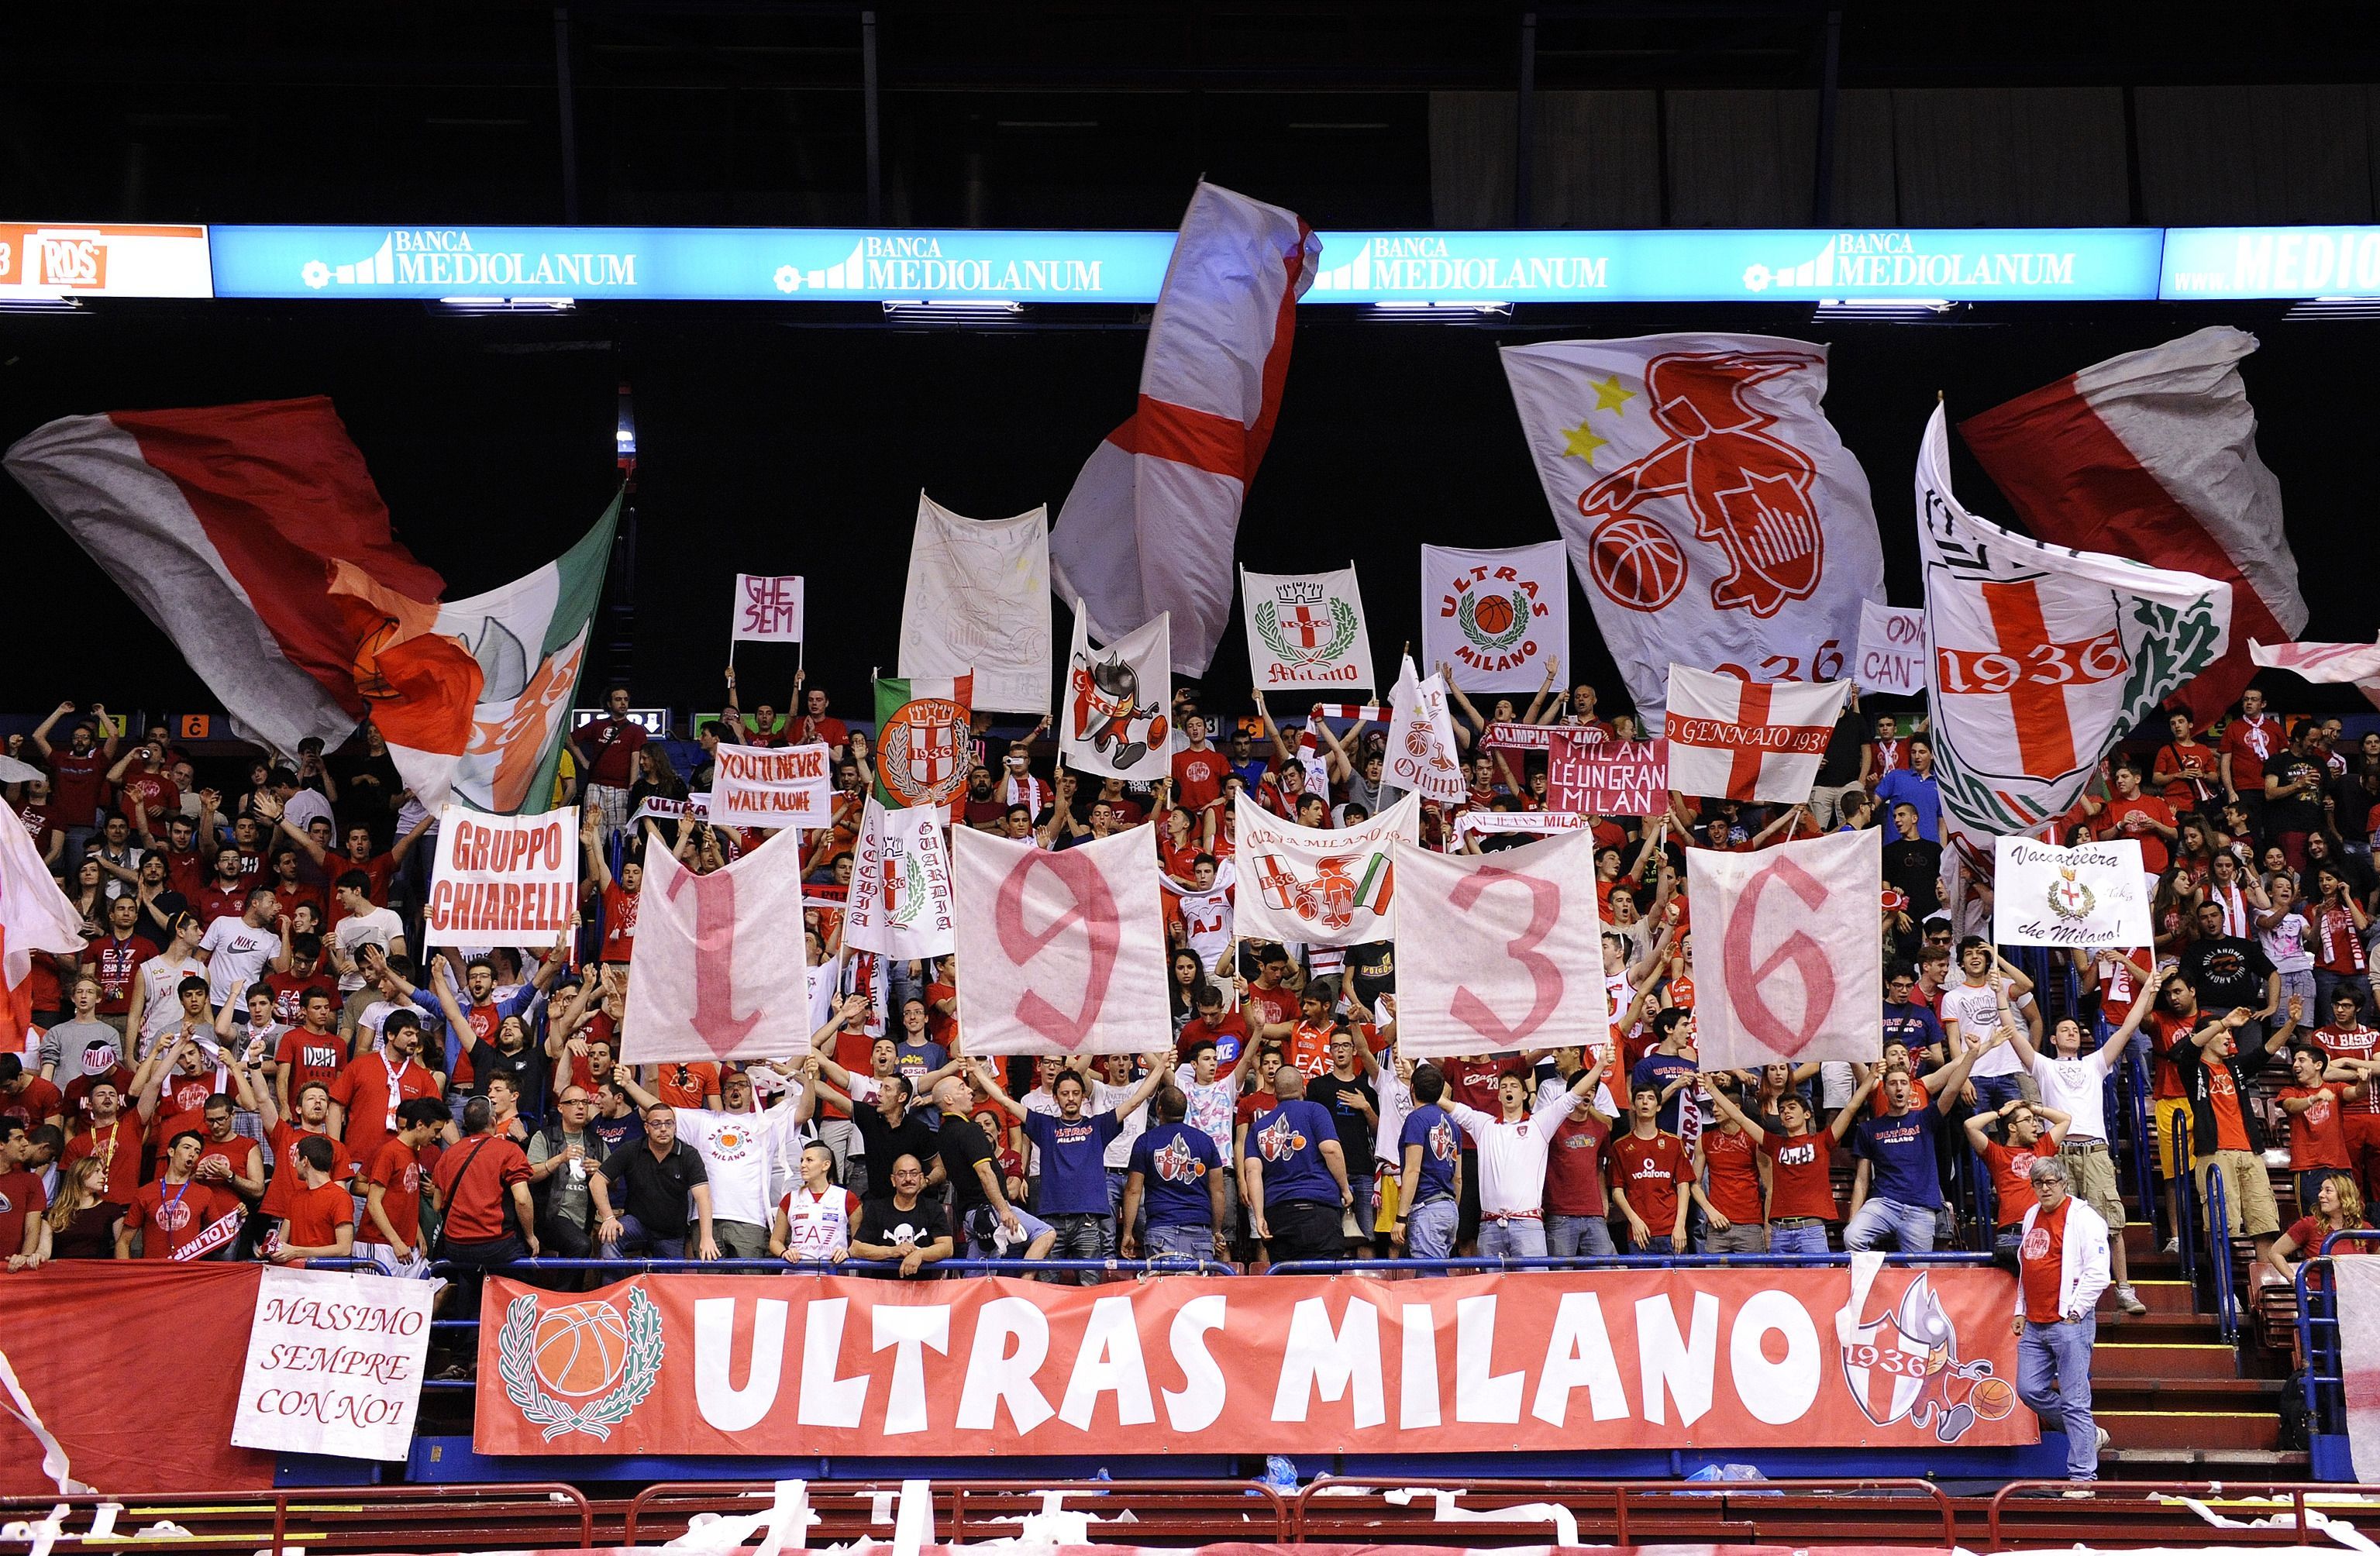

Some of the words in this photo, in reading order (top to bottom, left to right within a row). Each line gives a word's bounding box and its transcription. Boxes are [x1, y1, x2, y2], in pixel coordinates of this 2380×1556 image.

[395, 231, 472, 252] BANCA
[867, 237, 942, 257] BANCA
[1374, 237, 1448, 257] BANCA
[1838, 233, 1913, 253] BANCA
[44, 240, 97, 279] RDS
[397, 253, 636, 285] MEDIOLANUM
[1837, 254, 2075, 286] MEDIOLANUM
[867, 260, 1103, 291] MEDIOLANUM
[1373, 258, 1608, 290] MEDIOLANUM
[745, 576, 795, 606] GHE
[1441, 566, 1548, 617] ULTRAS
[742, 606, 793, 634] SEM
[1281, 619, 1331, 628] 1936
[1455, 641, 1537, 672] MILANO
[1939, 632, 2124, 694] 1936
[1269, 663, 1358, 683] Milano
[1864, 652, 1924, 688] CAN
[1494, 726, 1549, 745] OLIMPIA
[1667, 719, 1676, 737] 9
[1682, 720, 1790, 747] GENNAIO
[1791, 728, 1830, 752] 1936
[913, 745, 952, 760] 1936
[1566, 741, 1655, 763] MILAN
[777, 752, 823, 780] NEVER
[1394, 757, 1466, 798] Olimpi
[647, 796, 707, 815] ULTRA
[728, 790, 768, 812] WALK
[772, 790, 810, 812] ALONE
[1562, 787, 1652, 814] MILAN
[452, 820, 563, 875] GRUPPO
[1246, 829, 1298, 849] CURVA
[1304, 828, 1380, 849] MILANO
[881, 876, 906, 890] 936
[1260, 873, 1296, 890] 1936
[431, 879, 574, 932] CHIARELLI
[1191, 914, 1222, 938] AJ
[2017, 921, 2045, 939] che
[2050, 919, 2121, 945] Milano!
[234, 935, 258, 949] NIKE
[666, 866, 763, 1059] 1
[995, 848, 1121, 1051] 9
[1448, 866, 1564, 1046] 3
[1723, 855, 1836, 1059] 6
[2203, 947, 2245, 966] BILLABONG
[1653, 1065, 1693, 1076] ULTRA
[1486, 1077, 1499, 1090] 23
[708, 1124, 753, 1145] ULTRAS
[1055, 1124, 1093, 1138] ULTRAS
[1057, 1135, 1086, 1145] MILANO
[1884, 1135, 1914, 1144] MILANO
[711, 1150, 746, 1162] MILANO
[1631, 1169, 1671, 1180] vodafone
[158, 1208, 188, 1222] OLMPIA
[173, 1225, 222, 1262] OLIMP
[792, 1225, 837, 1244] EA7
[263, 1296, 424, 1337] MASSIMO
[260, 1344, 411, 1383] SEMPRE
[694, 1293, 1228, 1436] ULTRAS
[1270, 1289, 1821, 1430] MILANO
[1846, 1344, 1926, 1379] 1936
[256, 1389, 332, 1427] CON
[333, 1392, 405, 1427] NOI
